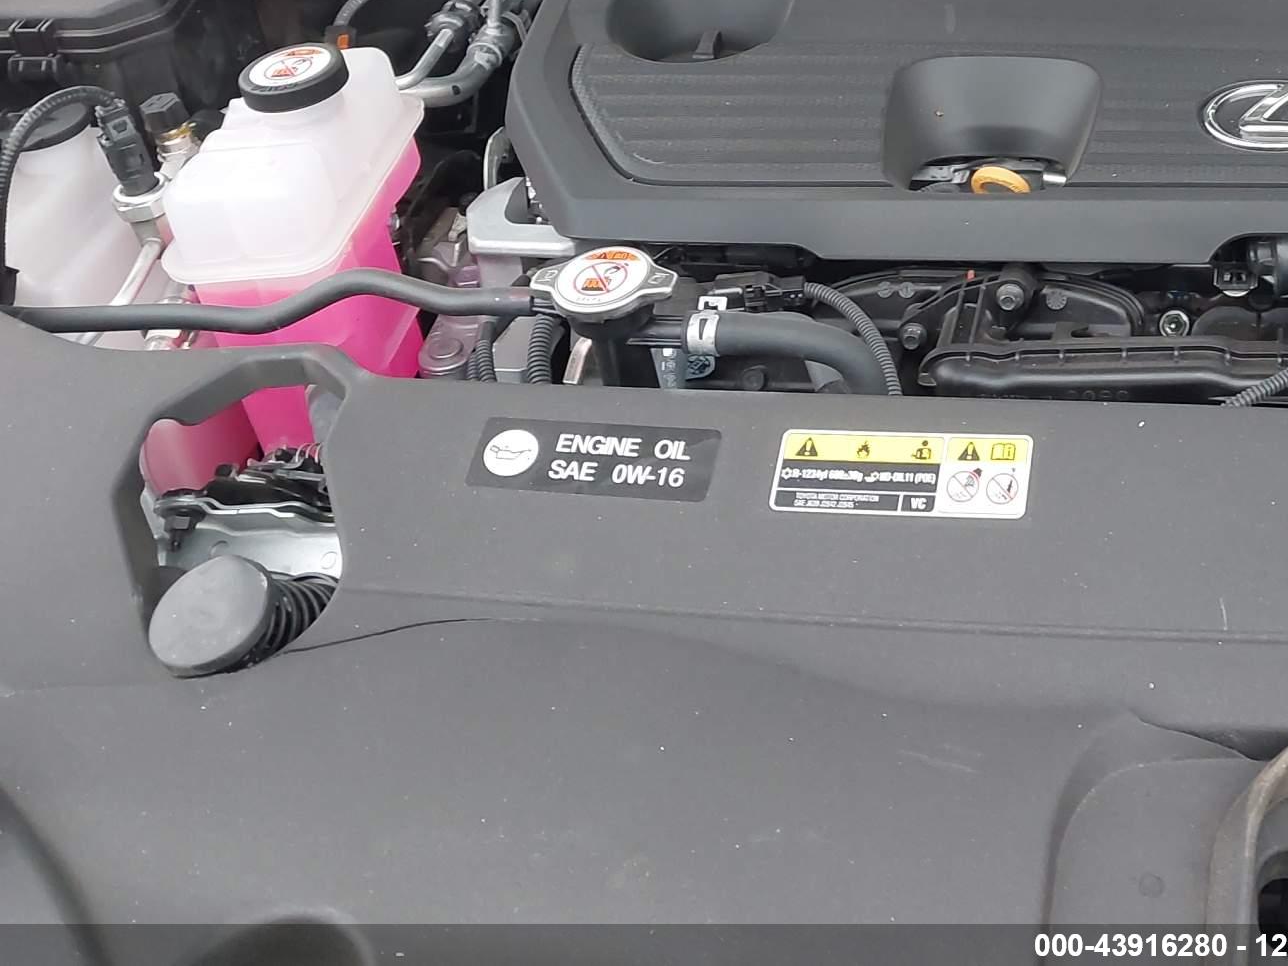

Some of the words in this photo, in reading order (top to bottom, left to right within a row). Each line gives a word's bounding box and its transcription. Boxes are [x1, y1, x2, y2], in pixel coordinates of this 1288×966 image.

[555, 433, 642, 458] ENGINE
[654, 439, 691, 461] OIL
[547, 459, 599, 482] SAE
[611, 465, 685, 488] 0W-16
[910, 497, 928, 510] VC
